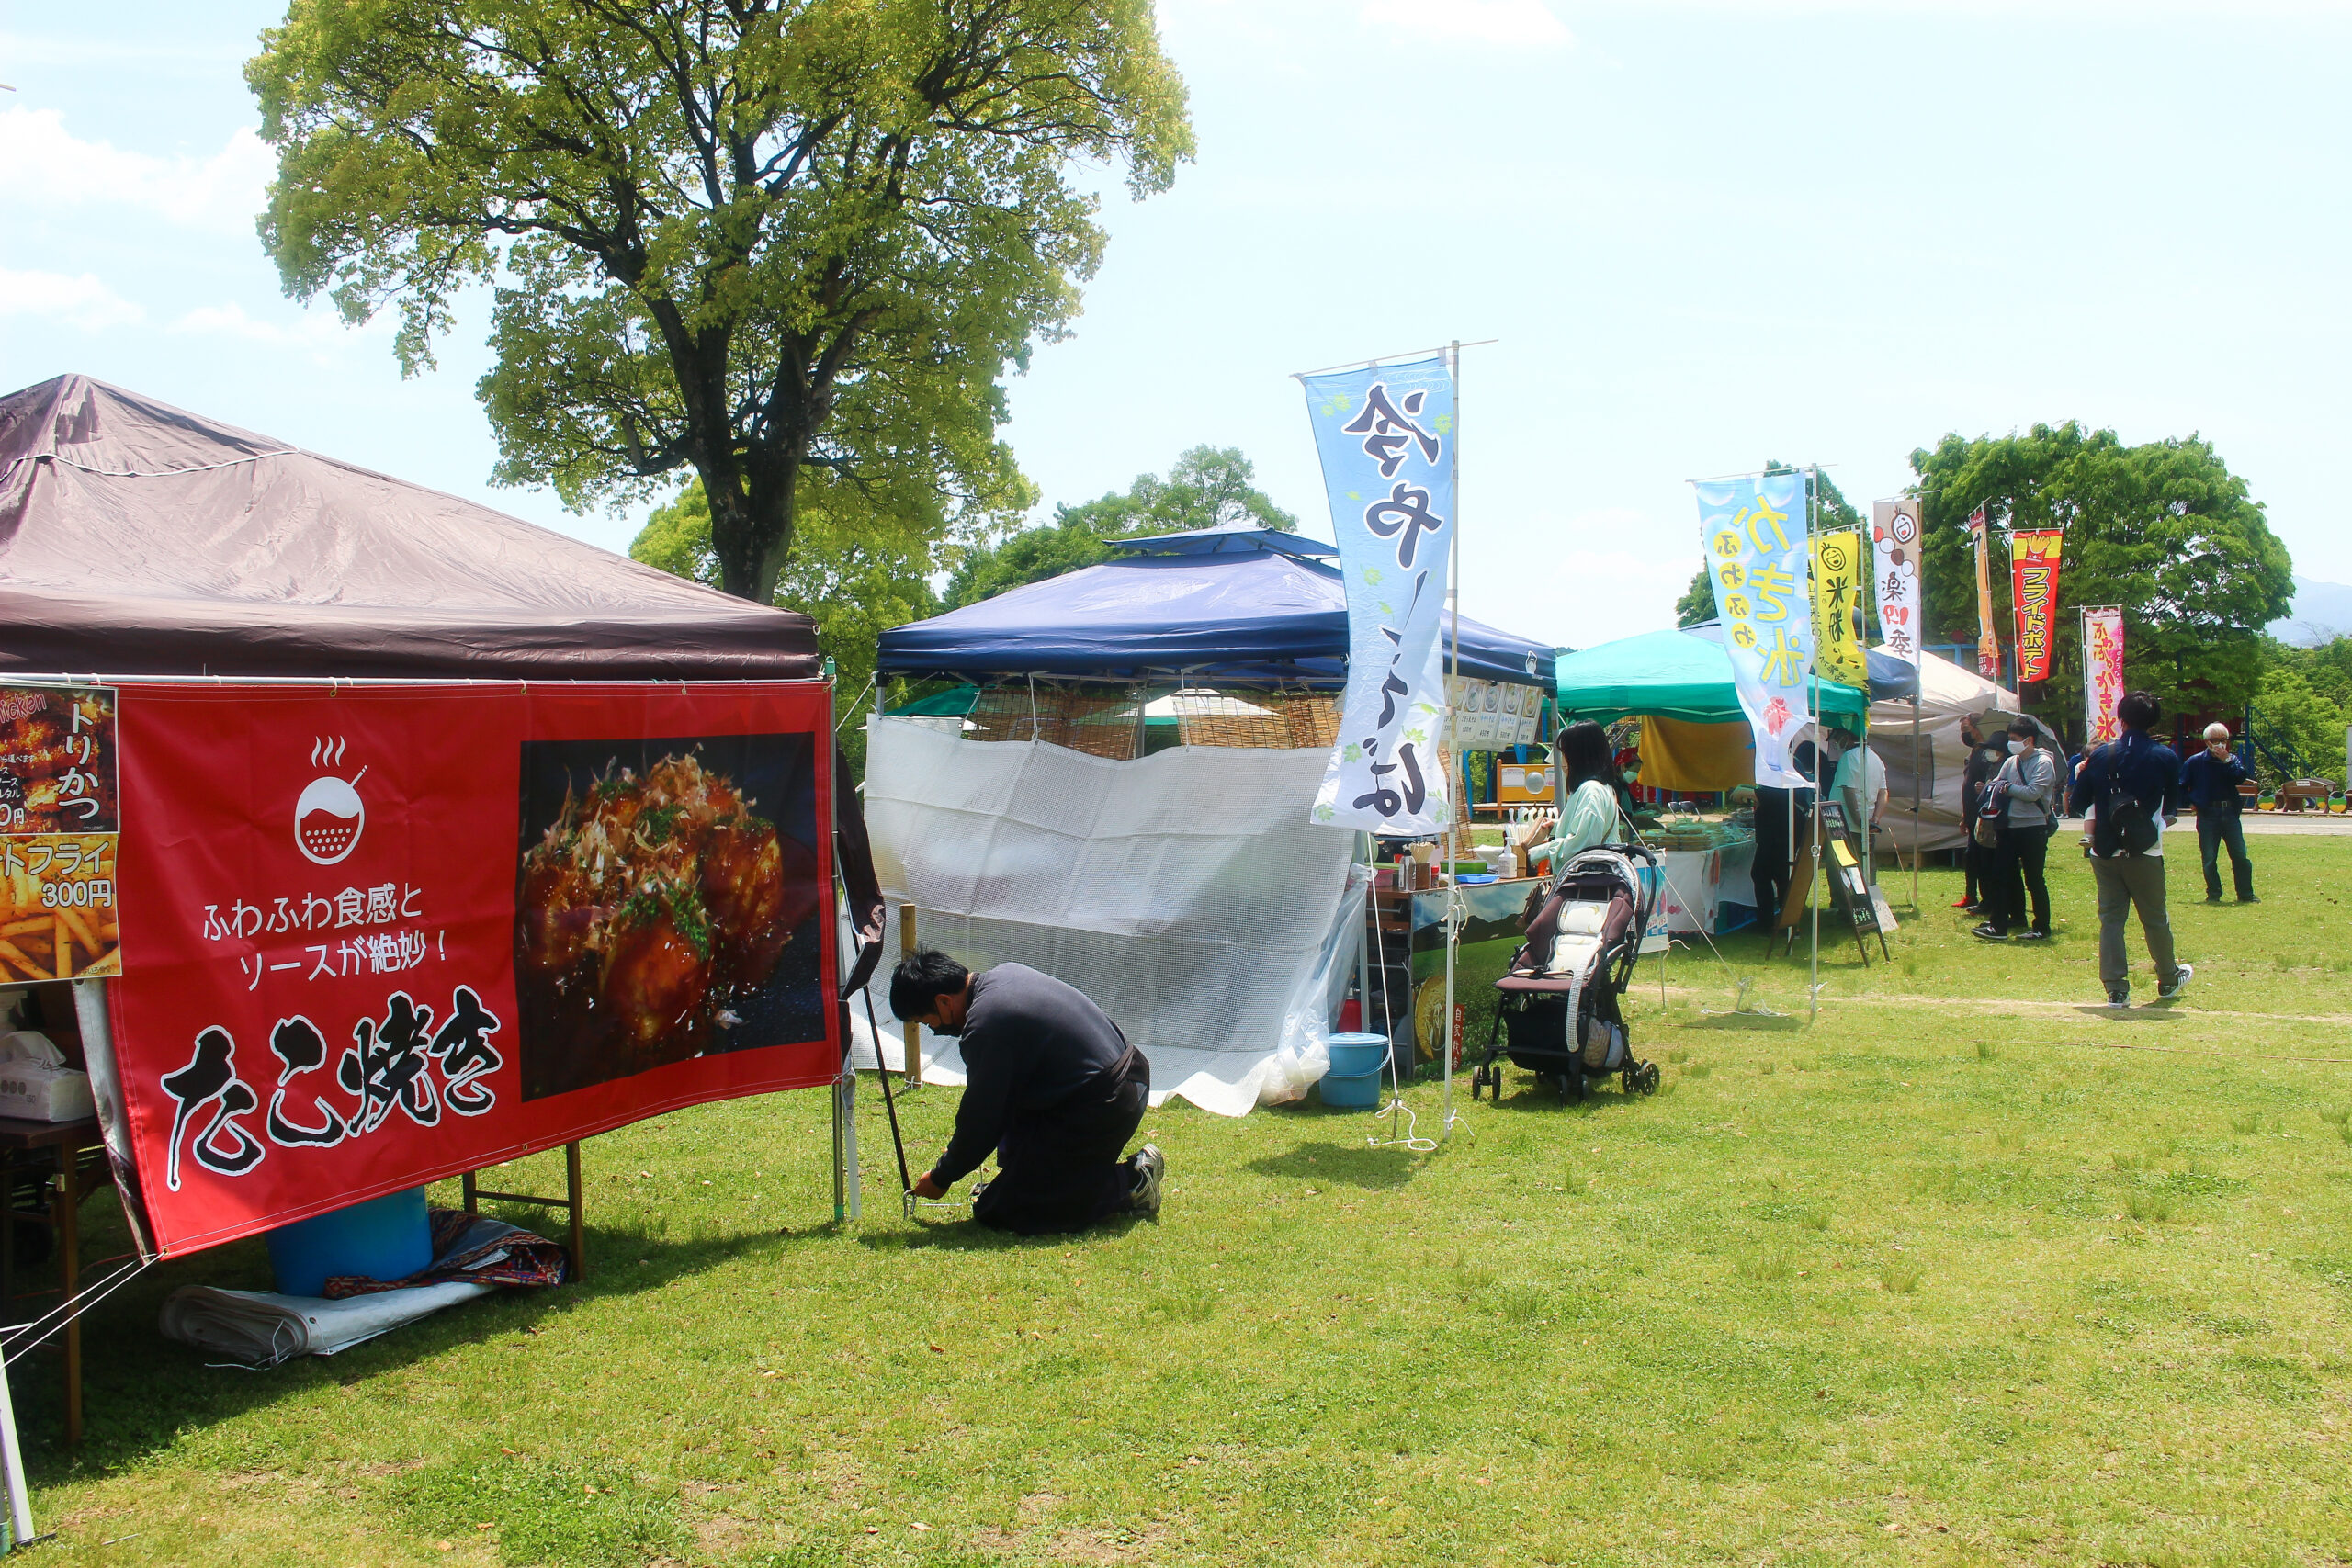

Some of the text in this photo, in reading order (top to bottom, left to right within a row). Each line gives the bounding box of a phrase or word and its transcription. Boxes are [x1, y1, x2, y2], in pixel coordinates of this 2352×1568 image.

[2021, 566, 2052, 681] フライドポテト
[0, 766, 9, 774] ス
[58, 702, 100, 820] トリかつ
[0, 841, 109, 877] トフライ
[42, 879, 112, 908] 300円
[203, 882, 423, 942] ふわふわ食感と
[239, 930, 446, 991] ソースが絶妙！
[161, 984, 503, 1192] たこ焼き
